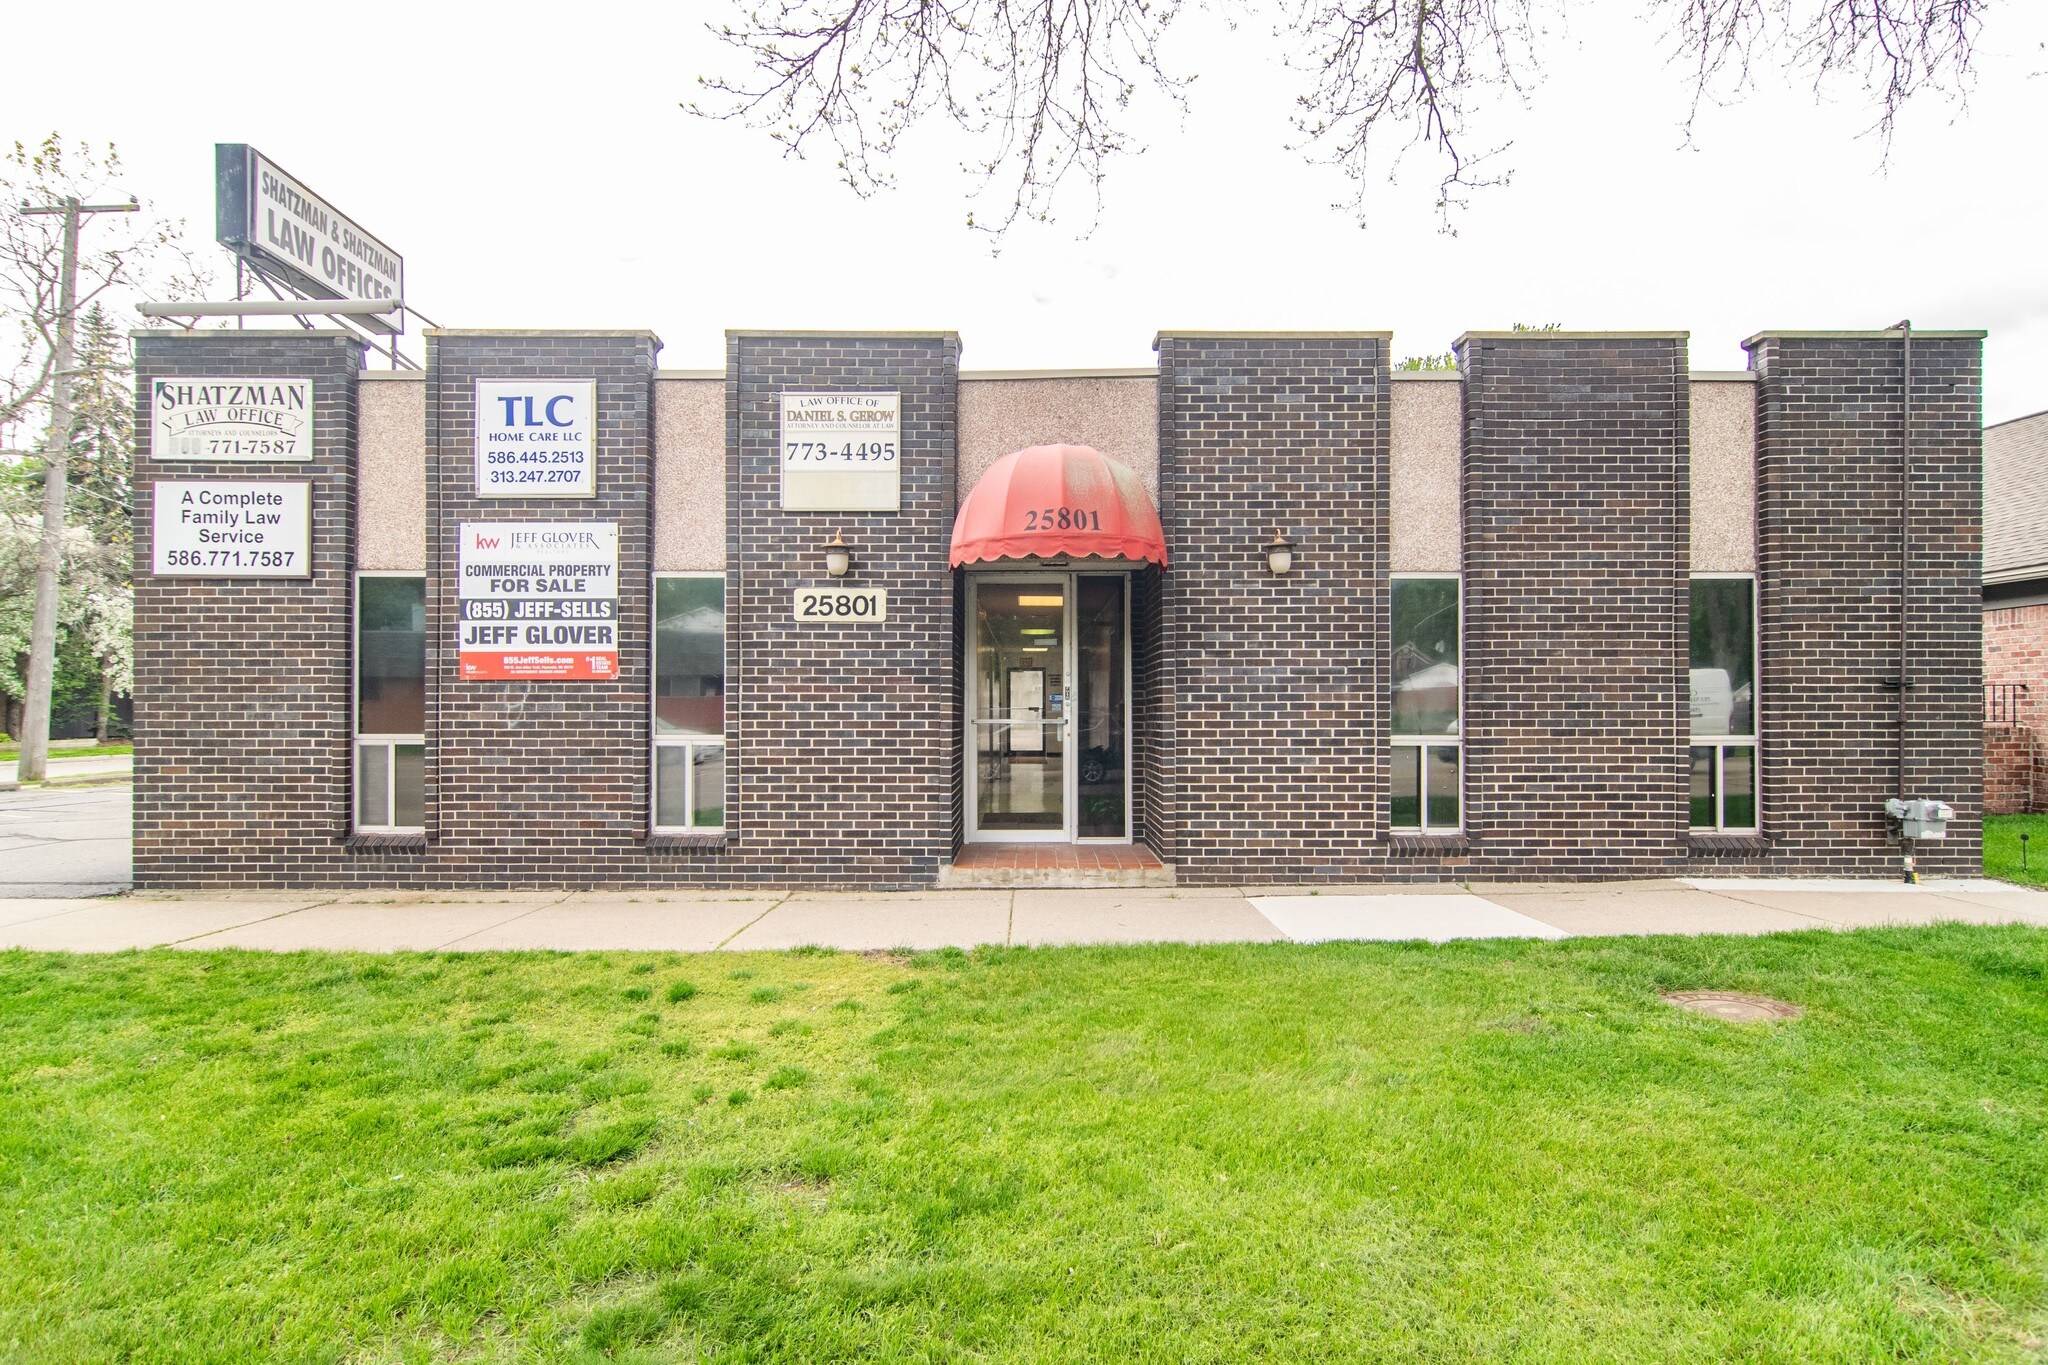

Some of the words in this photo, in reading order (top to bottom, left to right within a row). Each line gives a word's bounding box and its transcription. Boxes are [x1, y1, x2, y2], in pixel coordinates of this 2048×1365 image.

[261, 170, 328, 236] SHATZMAN
[331, 220, 341, 245] &
[343, 231, 397, 283] SHATZMAN
[268, 207, 315, 268] LAW
[161, 384, 305, 411] SHATZMAN
[800, 398, 823, 408] LAW
[826, 396, 863, 406] OFFICE
[865, 398, 880, 408] OF
[184, 409, 218, 426] LAW
[227, 408, 284, 426] OFFICE
[497, 395, 574, 427] TLC
[786, 410, 834, 422] DANIEL
[837, 410, 847, 422] S.
[849, 410, 895, 422] GEROW
[489, 433, 524, 442] HOME
[529, 433, 558, 442] CARE
[563, 432, 582, 442] LLC
[487, 451, 584, 464] 586.445.2513
[786, 442, 895, 462] 773-4495
[490, 470, 581, 483] 313.247.2707
[181, 490, 194, 505] A
[199, 490, 283, 508] Complete
[181, 510, 239, 527] Family
[245, 510, 281, 525] Law
[1023, 506, 1103, 532] 25801
[199, 529, 264, 543] Service
[476, 533, 500, 549] kw
[510, 532, 538, 549] JEFF
[542, 532, 600, 549] GLOVER
[167, 550, 295, 567] 586.771.7587
[465, 564, 545, 577] COMMERCIAL
[549, 564, 611, 577] PROPERTY
[490, 579, 530, 592] FOR
[535, 579, 586, 592] SALE
[465, 600, 509, 619] (855)
[514, 601, 611, 618] JEFF-SELLS
[802, 595, 877, 616] 25801
[464, 625, 518, 645] JEFF
[525, 625, 612, 645] GLOVER
[503, 656, 574, 664] 855JeffSells.com
